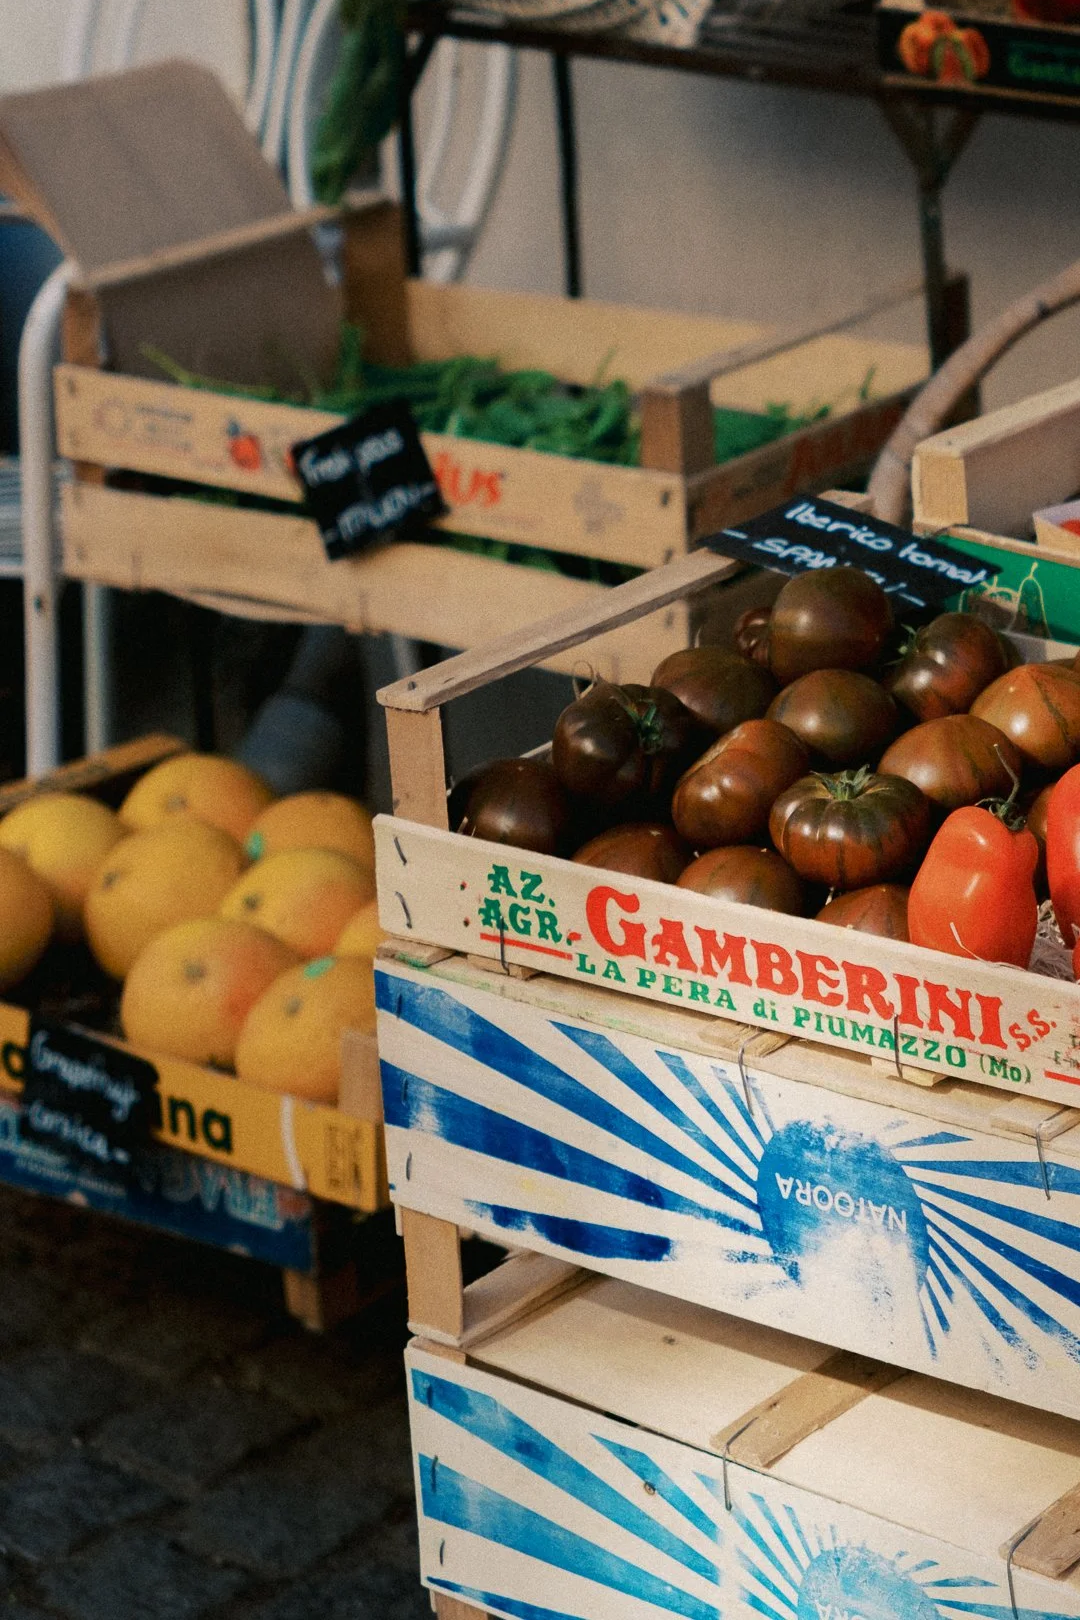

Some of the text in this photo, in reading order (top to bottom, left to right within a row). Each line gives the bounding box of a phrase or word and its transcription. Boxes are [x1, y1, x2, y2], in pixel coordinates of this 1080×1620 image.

[785, 503, 990, 585] Iberico tomat
[487, 864, 555, 908] AZ.
[478, 898, 574, 947] AGR.
[585, 886, 1008, 1050] GAMBERINI
[576, 952, 624, 983] LA
[636, 967, 738, 1011] PERA
[752, 996, 778, 1023] di
[793, 1006, 968, 1069] PIUMAZZO
[775, 1172, 907, 1233] NATOORA
